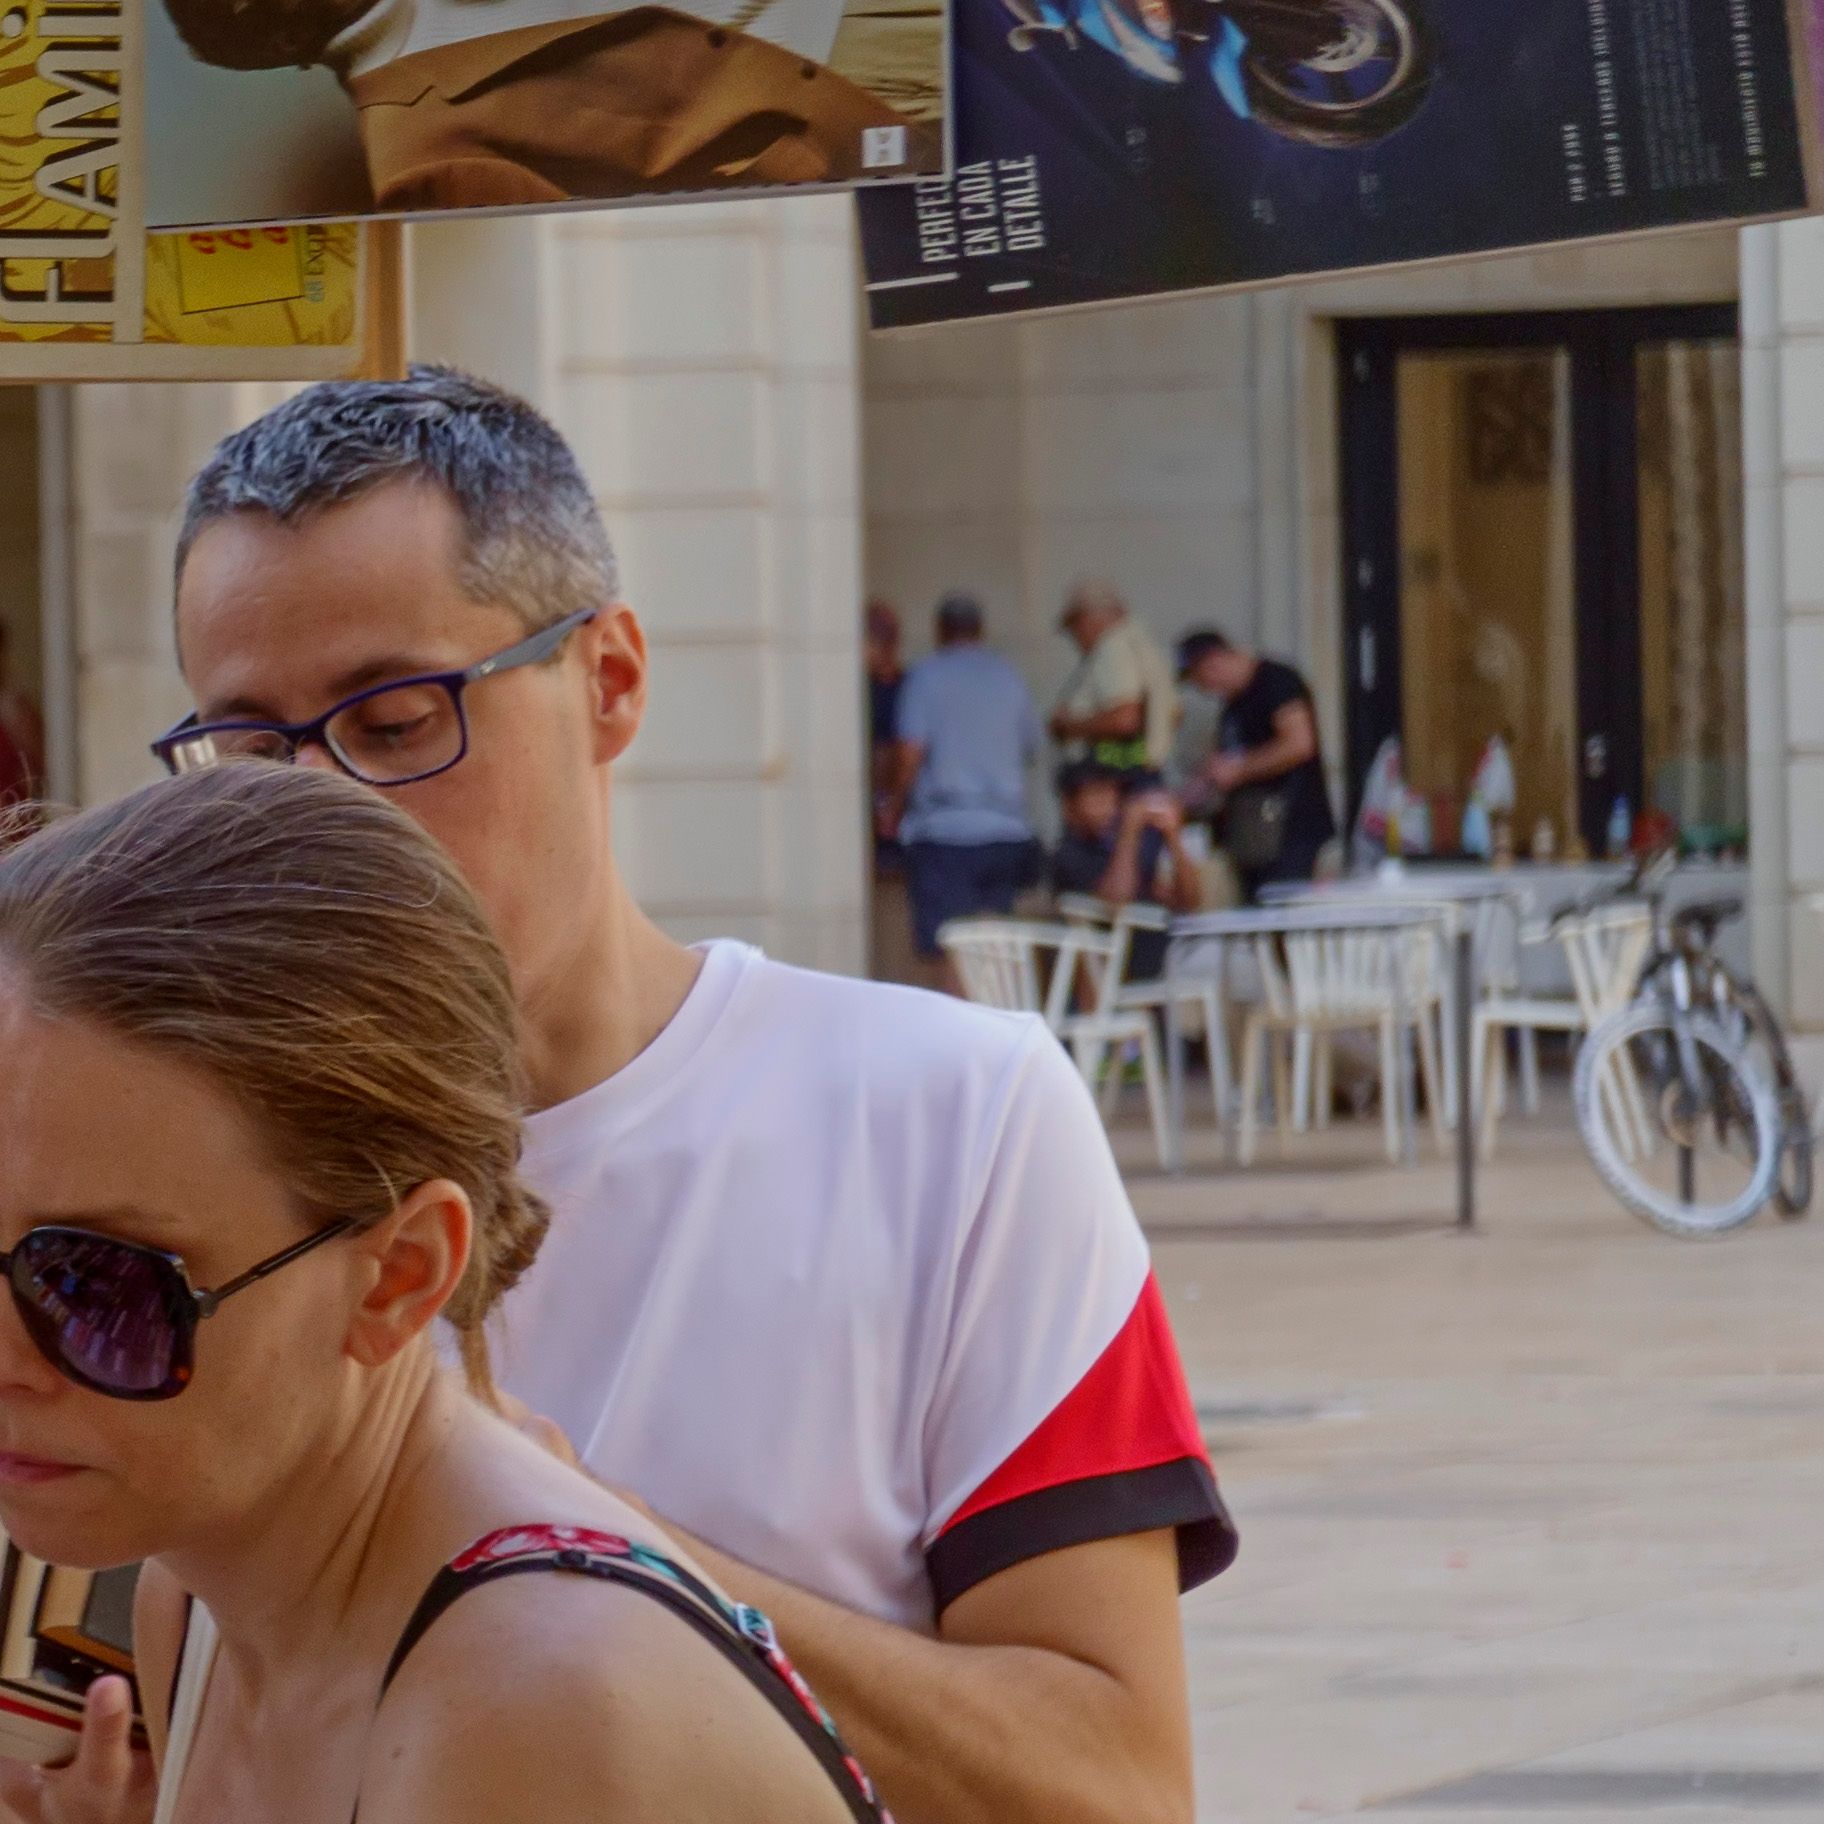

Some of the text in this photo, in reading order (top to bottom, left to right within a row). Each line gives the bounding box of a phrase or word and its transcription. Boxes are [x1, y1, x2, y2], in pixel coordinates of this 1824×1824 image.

[955, 160, 1002, 257] EN CADA
[997, 154, 1047, 252] DETALLE
